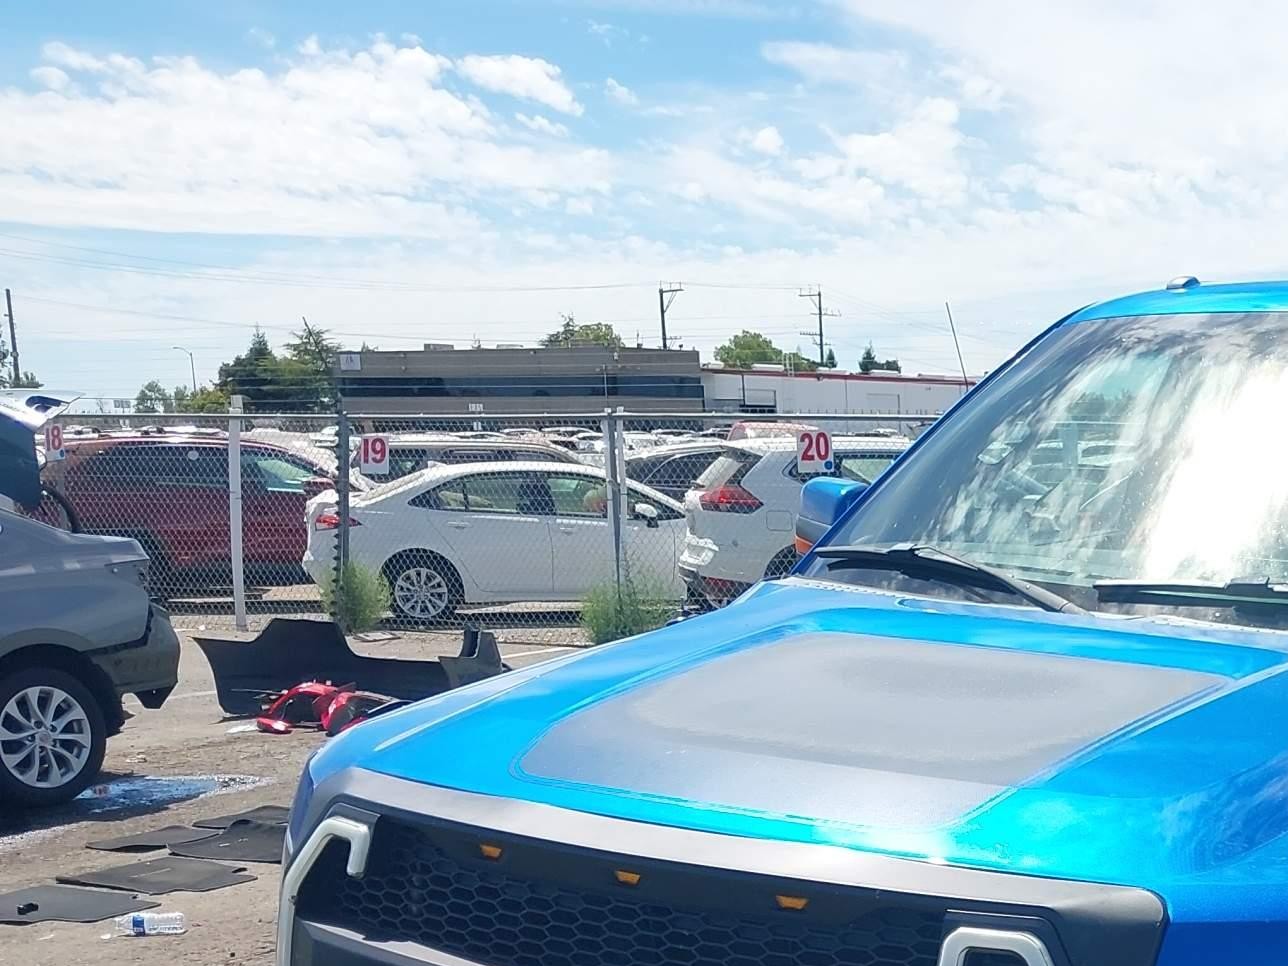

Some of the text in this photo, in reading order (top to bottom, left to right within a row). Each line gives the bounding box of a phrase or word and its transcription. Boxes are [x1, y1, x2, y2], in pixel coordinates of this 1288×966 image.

[45, 425, 62, 452] 18
[363, 438, 387, 464] 19
[800, 431, 829, 461] 20
